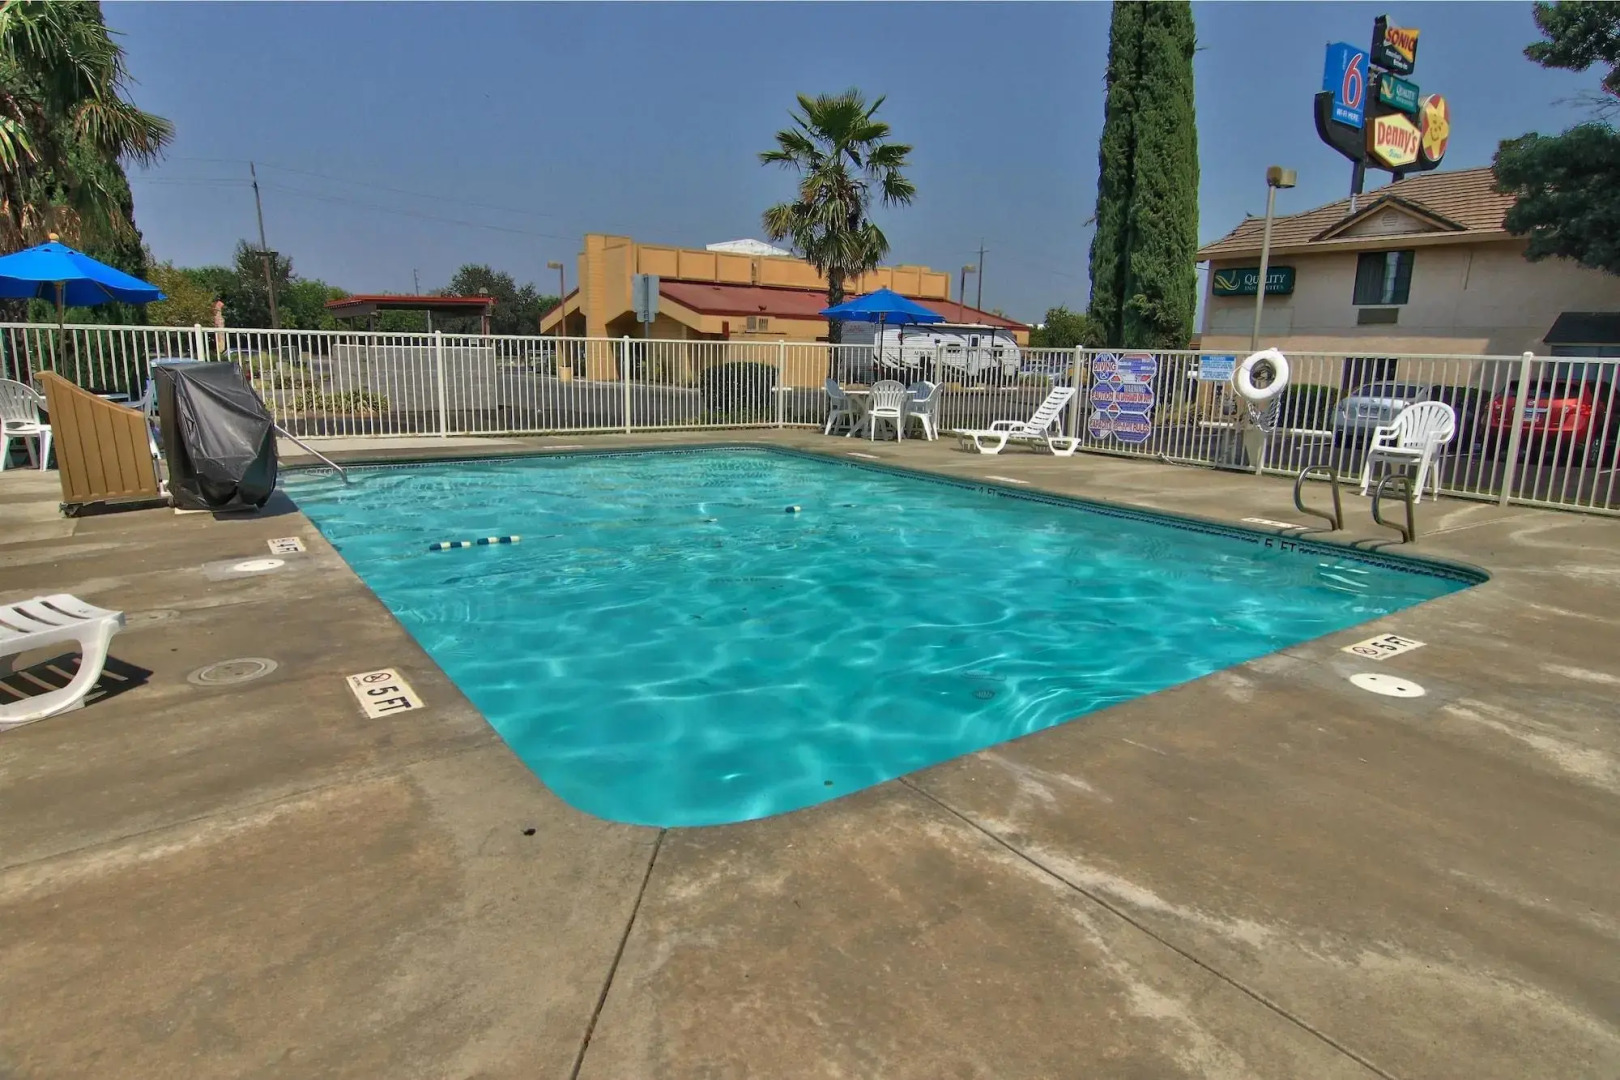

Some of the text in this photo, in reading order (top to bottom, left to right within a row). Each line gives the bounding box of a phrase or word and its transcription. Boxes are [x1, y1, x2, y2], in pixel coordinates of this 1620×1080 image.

[1387, 27, 1417, 52] SONIC
[1342, 52, 1363, 110] 6
[1347, 110, 1360, 121] HERE
[1376, 121, 1418, 154] Denny's
[1244, 273, 1286, 286] QULITY
[1100, 354, 1111, 362] NO
[1094, 362, 1116, 371] DIVING
[1280, 540, 1297, 552] FT
[1371, 636, 1415, 651] 5 FT
[367, 685, 412, 712] 5 FT
